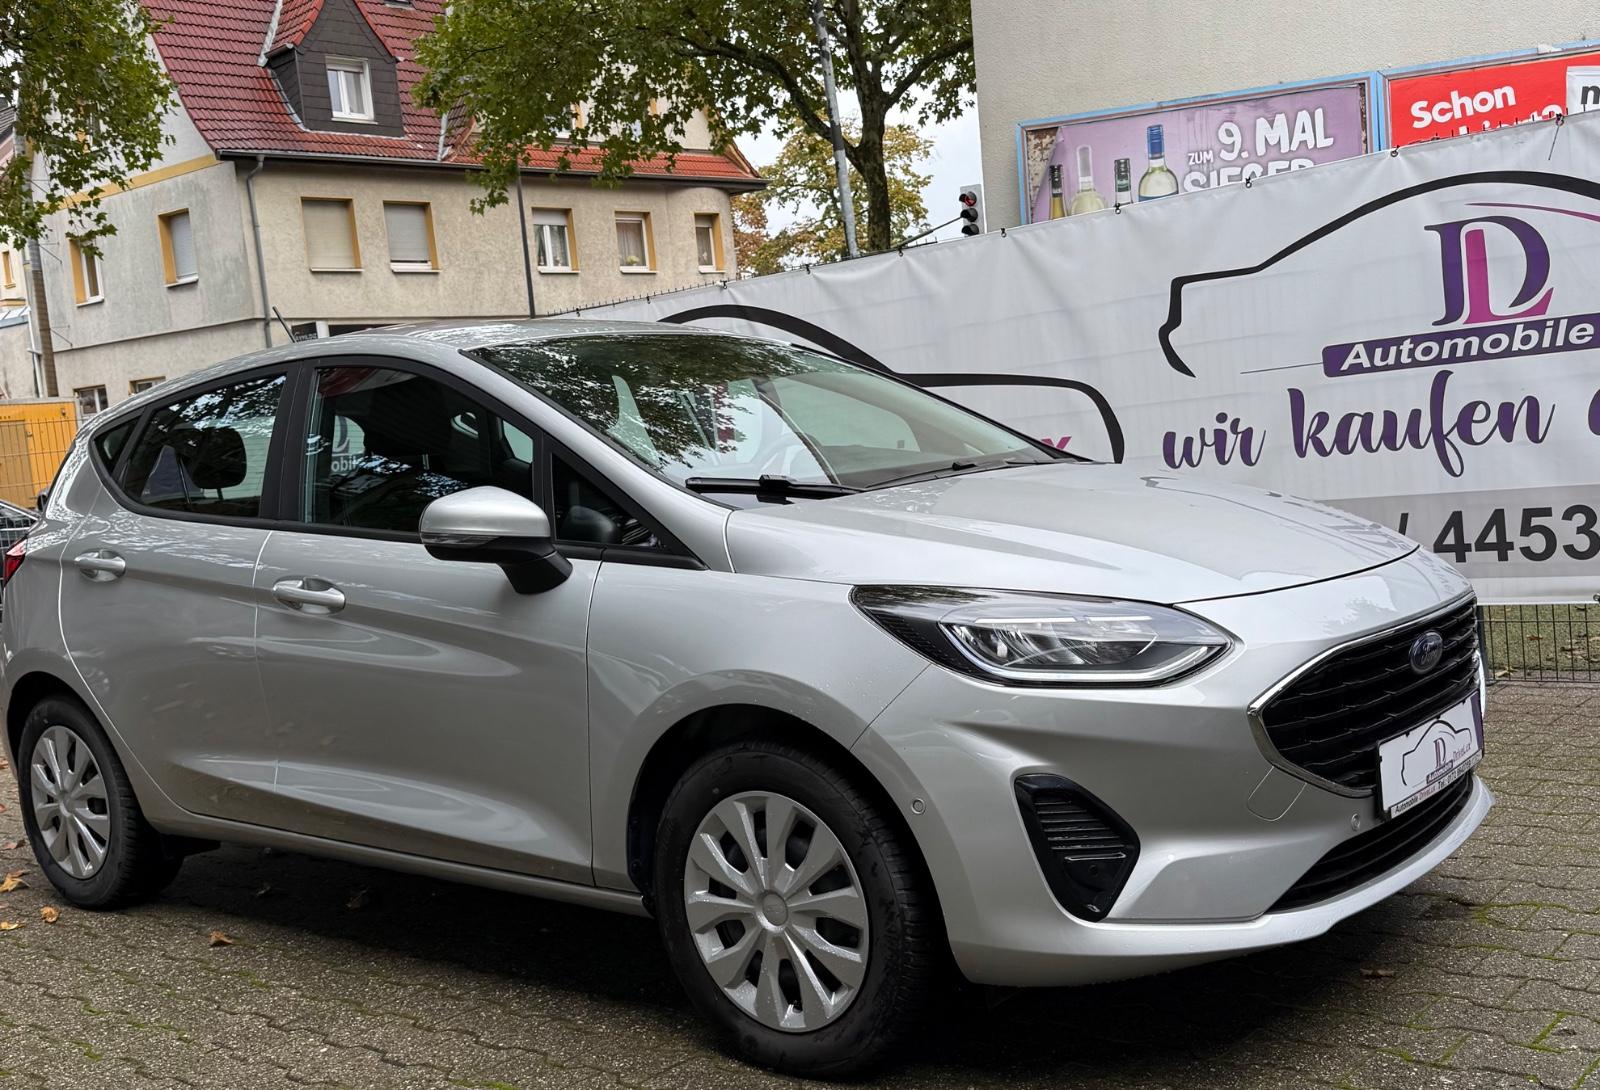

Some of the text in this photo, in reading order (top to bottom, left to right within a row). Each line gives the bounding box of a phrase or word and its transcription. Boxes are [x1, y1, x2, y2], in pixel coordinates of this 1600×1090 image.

[1410, 85, 1517, 129] Schon
[1188, 150, 1214, 166] ZUM
[1217, 107, 1334, 161] 9. MAL
[1340, 318, 1595, 371] Automobile
[1162, 412, 1266, 470] wir
[1287, 370, 1556, 477] kaufen
[1433, 504, 1600, 563] 4453
